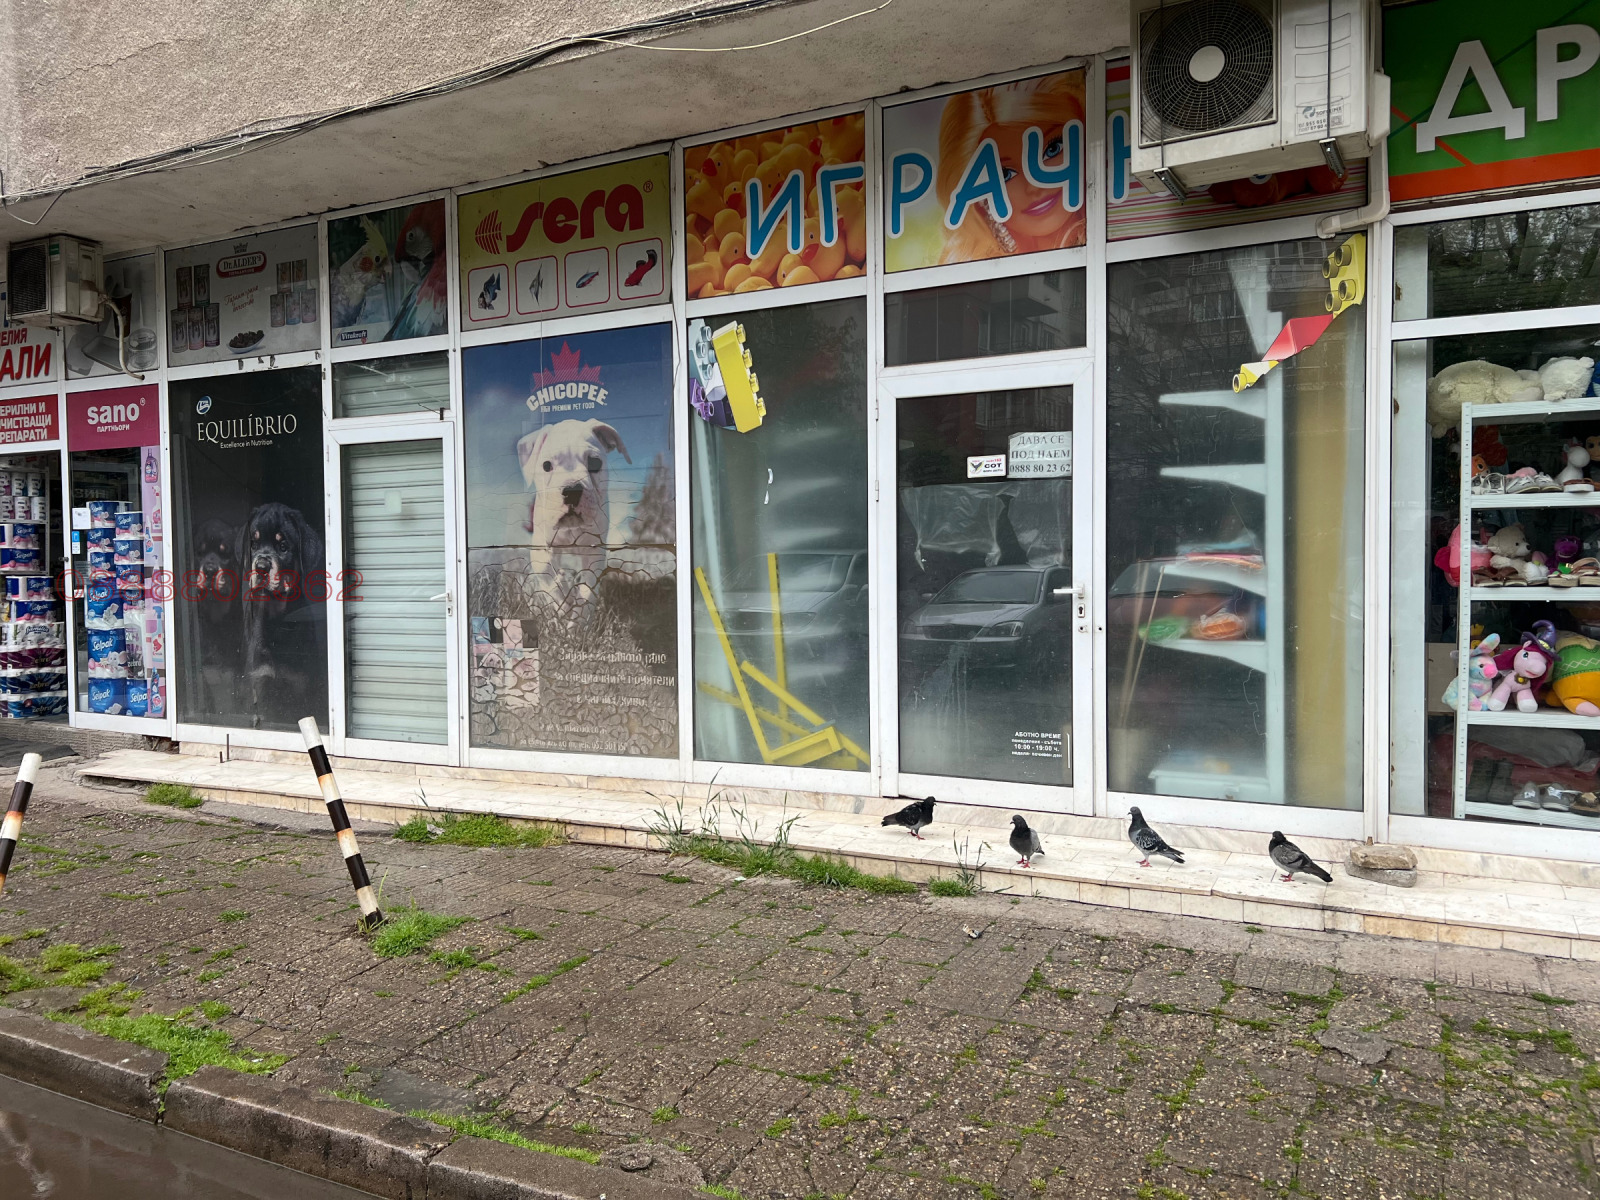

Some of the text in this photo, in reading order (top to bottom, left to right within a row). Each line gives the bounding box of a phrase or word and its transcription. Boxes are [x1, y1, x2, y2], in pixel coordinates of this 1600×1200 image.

[1416, 23, 1600, 154] ДР
[505, 184, 645, 253] sera
[0, 327, 28, 346] ЕЛИЯ
[341, 330, 367, 340] Vitakraft
[0, 342, 52, 382] АЛИ
[526, 382, 609, 411] CHICOPEE
[38, 401, 46, 413] И
[552, 403, 572, 412] PREMIUM
[572, 402, 581, 410] PET
[87, 403, 140, 425] sano
[0, 413, 52, 430] ЧИСТВАЩИ
[96, 423, 130, 433] ПАРТНЬОРИ
[197, 413, 297, 444] EQUILÍBRIO
[220, 440, 245, 449] Excellence
[250, 438, 273, 447] Nutrition
[1017, 435, 1065, 446] ДАВА СЕ
[1011, 449, 1071, 460] ПОД НАЕМ
[1009, 464, 1031, 473] 0888
[1033, 464, 1044, 473] 80
[1046, 464, 1057, 473] 23
[1060, 463, 1071, 473] 62
[92, 638, 114, 652] Selpak
[92, 689, 112, 702] Selpak
